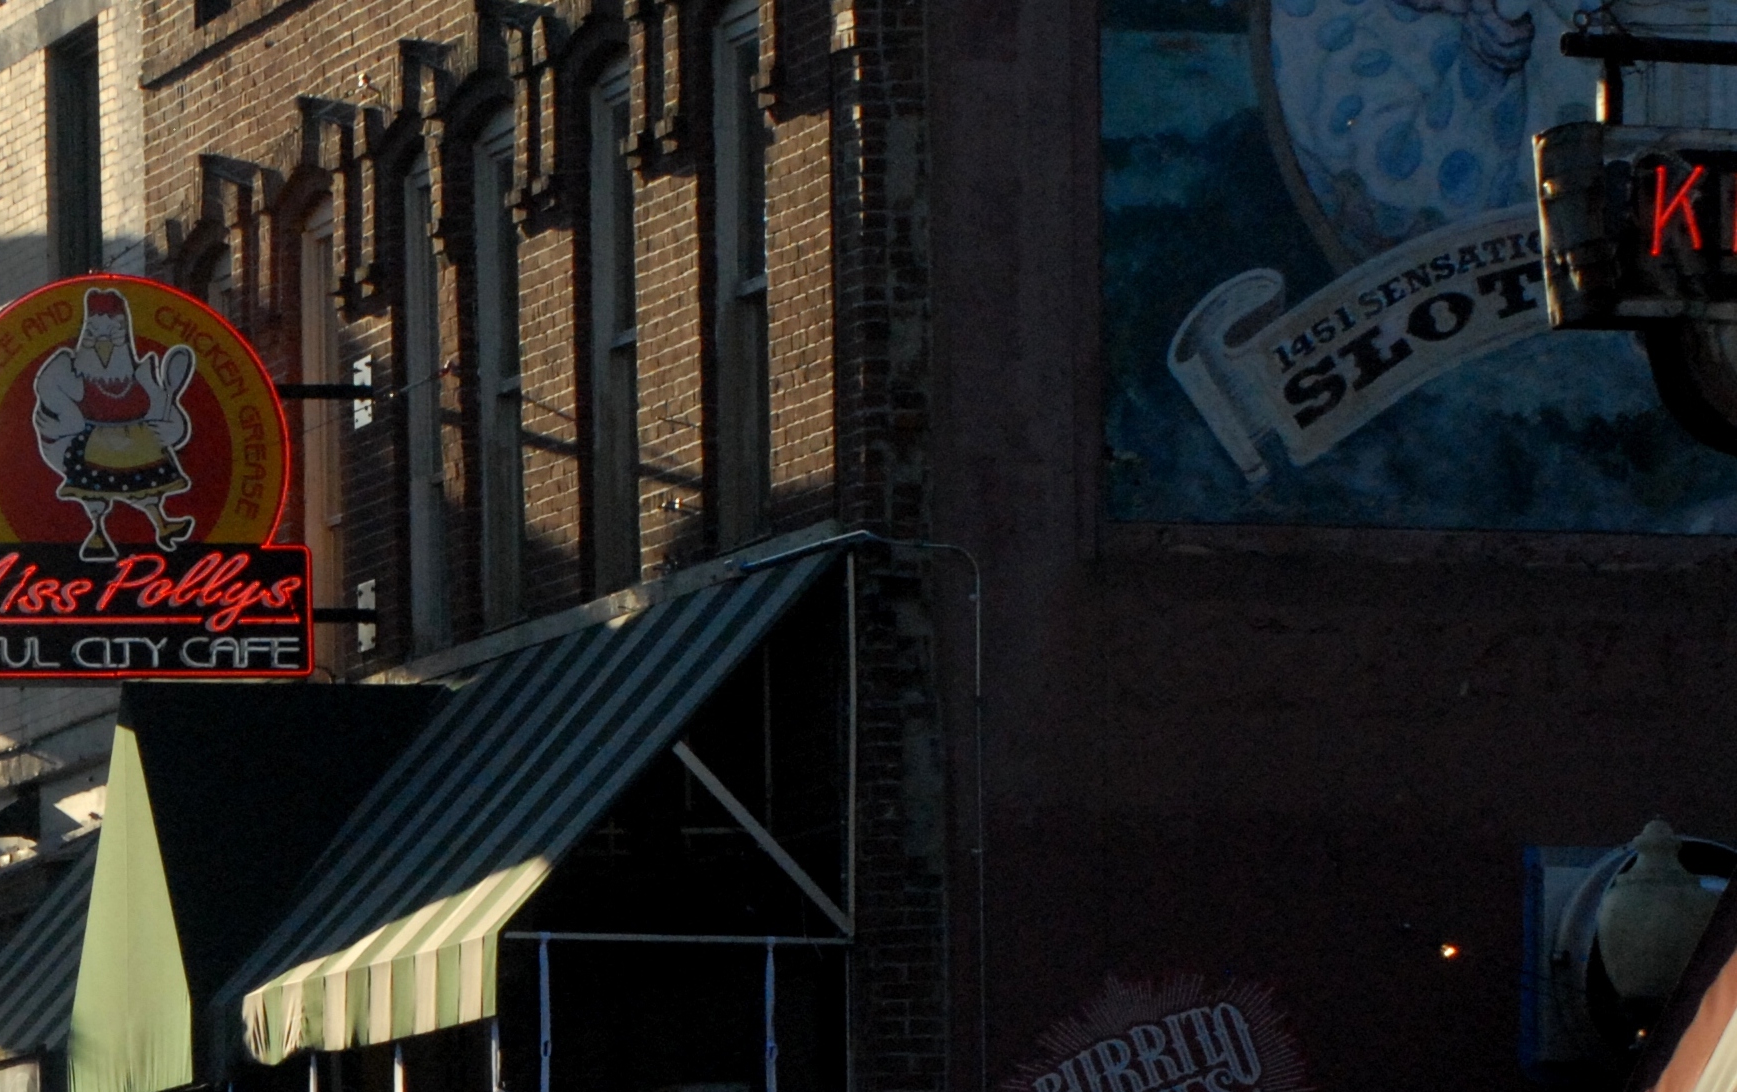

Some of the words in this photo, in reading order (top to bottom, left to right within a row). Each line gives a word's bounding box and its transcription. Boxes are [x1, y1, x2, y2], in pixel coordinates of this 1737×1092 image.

[20, 299, 74, 342] AND
[154, 305, 250, 400] CHICKEN
[234, 404, 268, 520] GREASE
[96, 552, 302, 633] Pollys
[71, 636, 167, 670] CITY
[179, 636, 301, 670] CAFE
